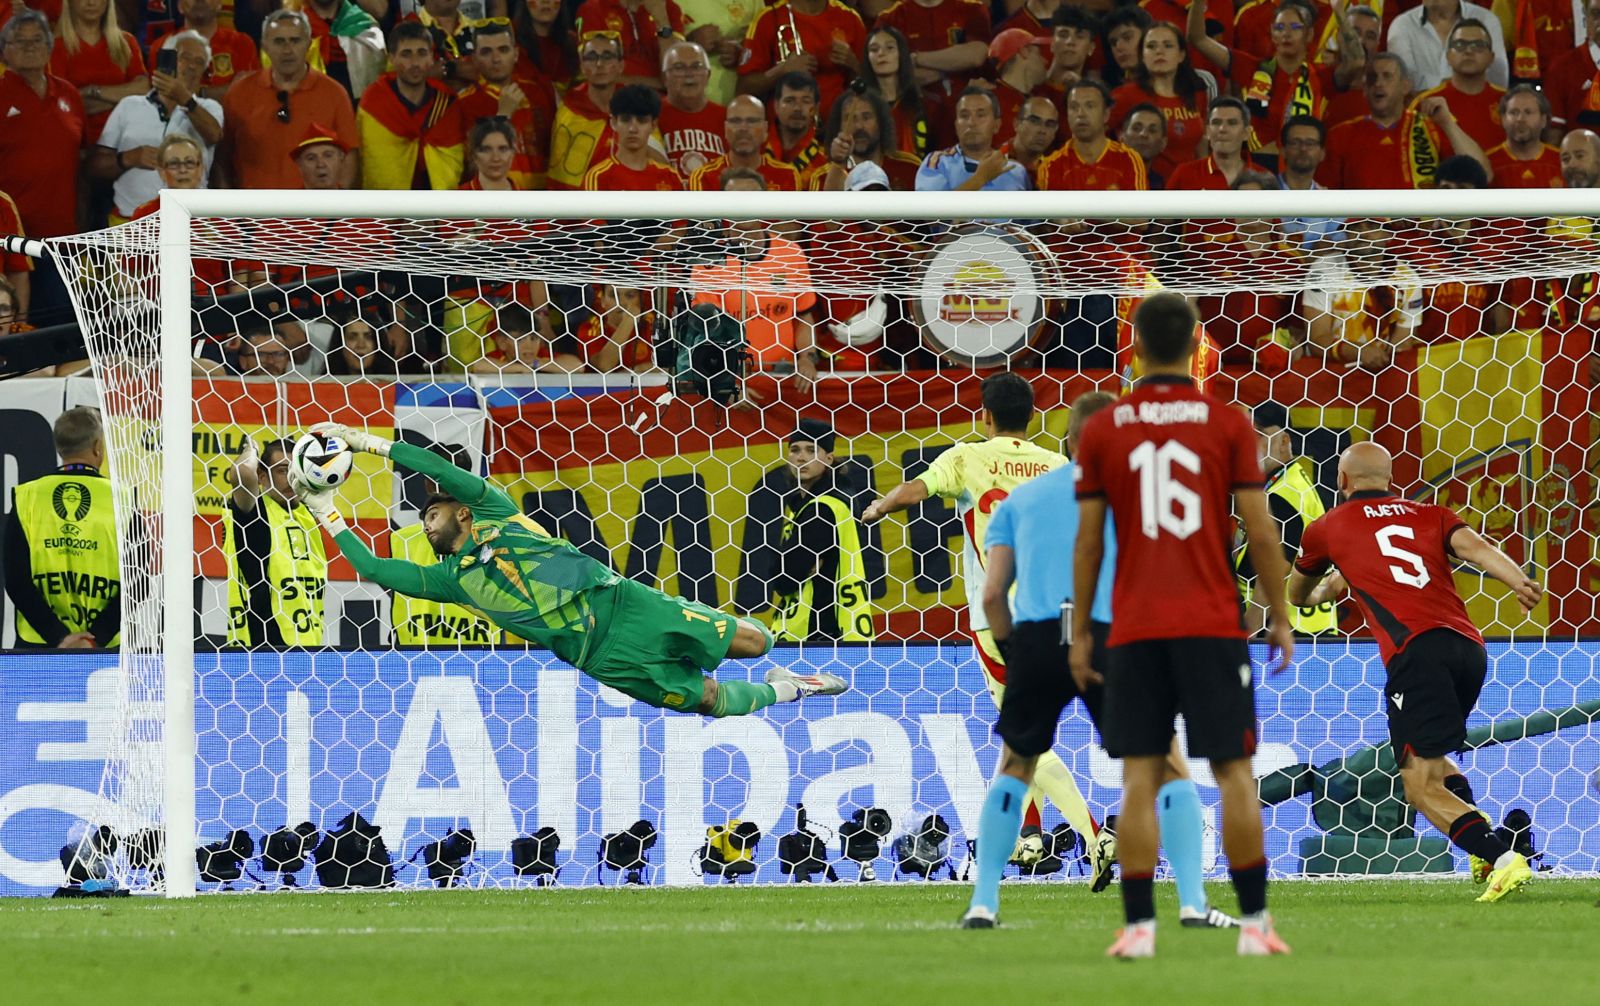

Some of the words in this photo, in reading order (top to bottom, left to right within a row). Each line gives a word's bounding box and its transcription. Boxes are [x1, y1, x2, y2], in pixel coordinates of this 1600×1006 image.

[1005, 461, 1049, 477] NAVAS
[1128, 439, 1202, 541] 16
[1363, 504, 1405, 519] AJETI
[1375, 523, 1431, 590] 5
